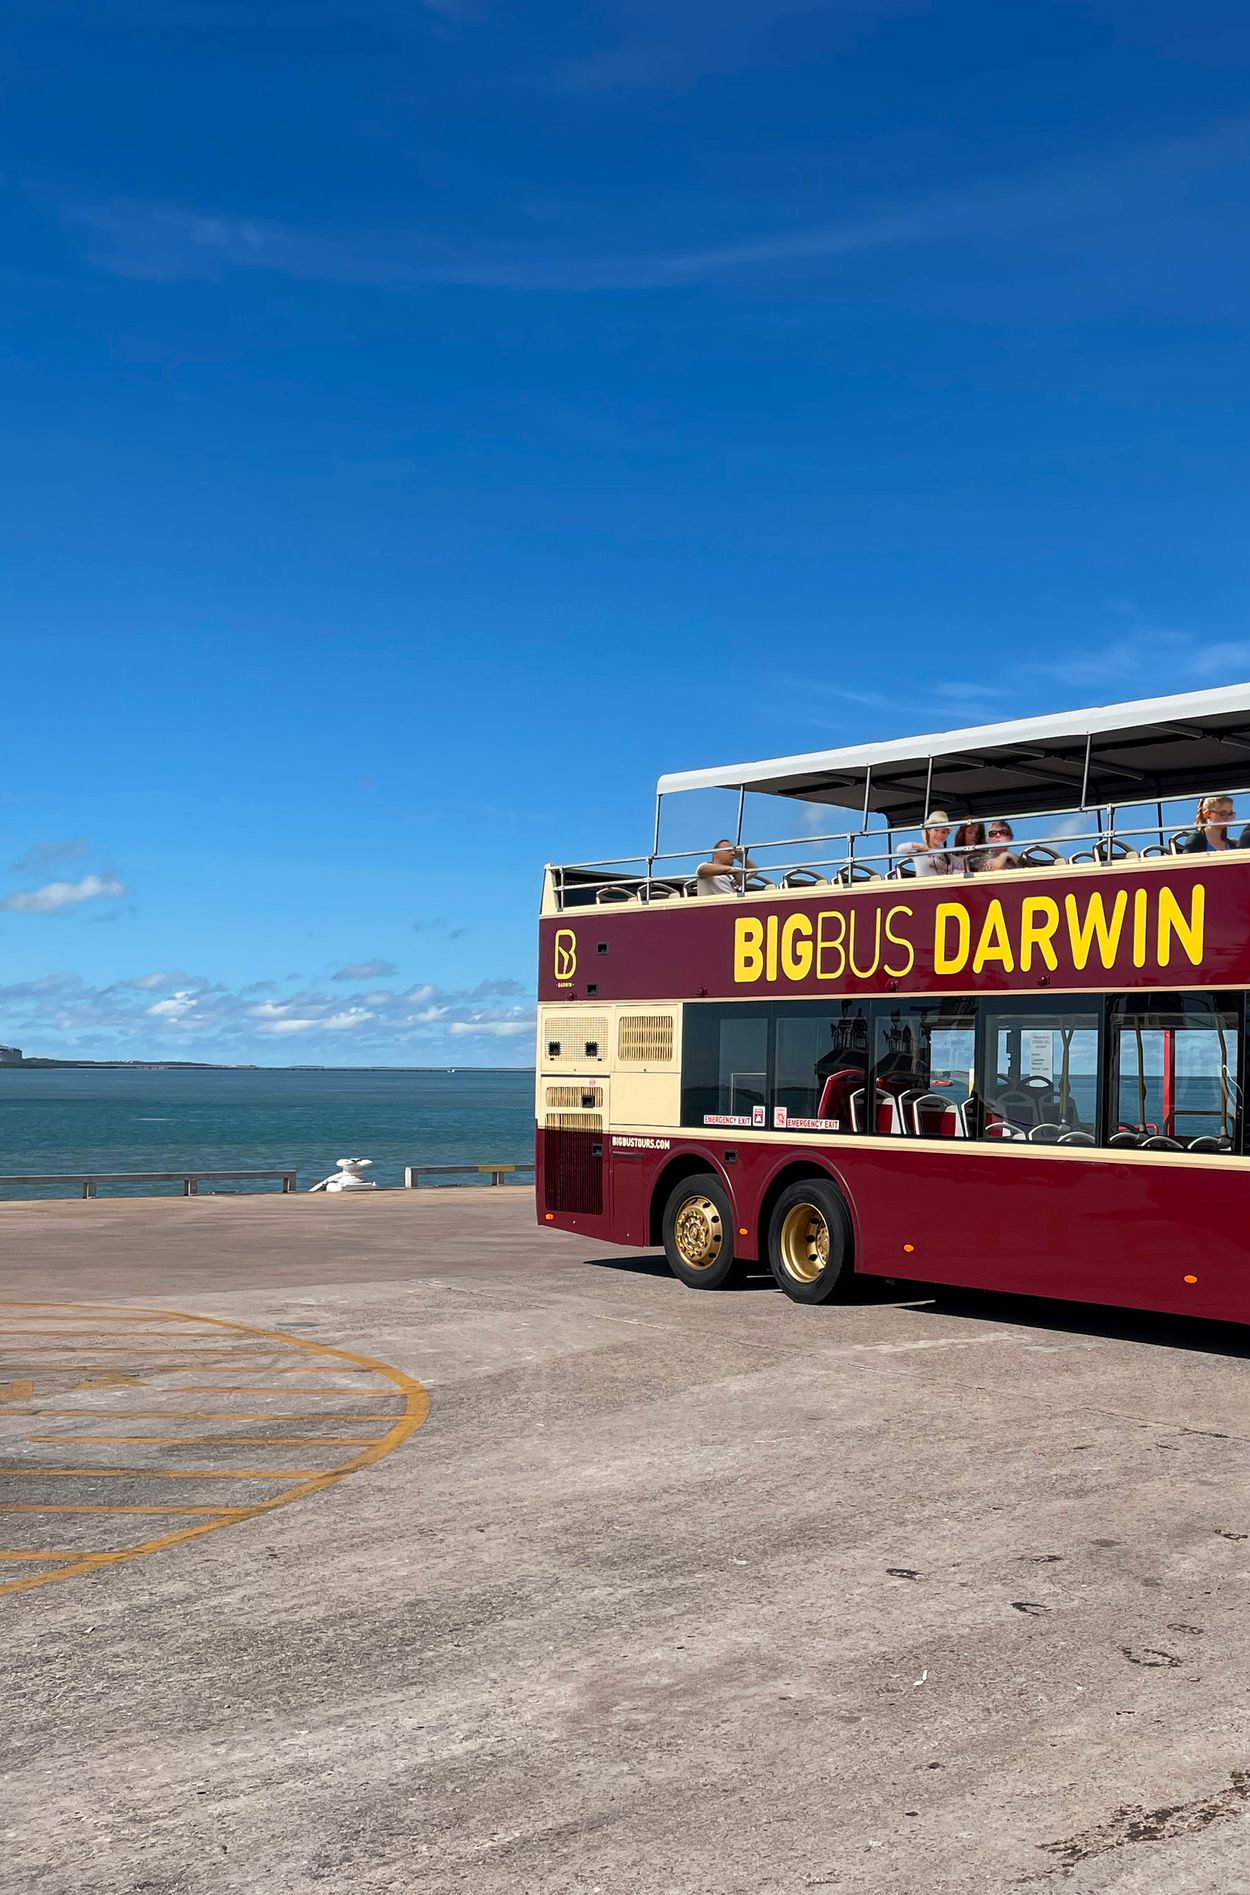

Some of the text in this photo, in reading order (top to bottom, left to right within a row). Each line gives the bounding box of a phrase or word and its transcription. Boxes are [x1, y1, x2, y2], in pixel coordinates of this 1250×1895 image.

[933, 883, 1206, 974] DARWIN
[704, 1116, 751, 1126] EMERGENCY EXIT
[787, 1119, 838, 1129] EMERGENCY EXIT
[611, 1136, 671, 1150] BIGBUSTOURS.COM
